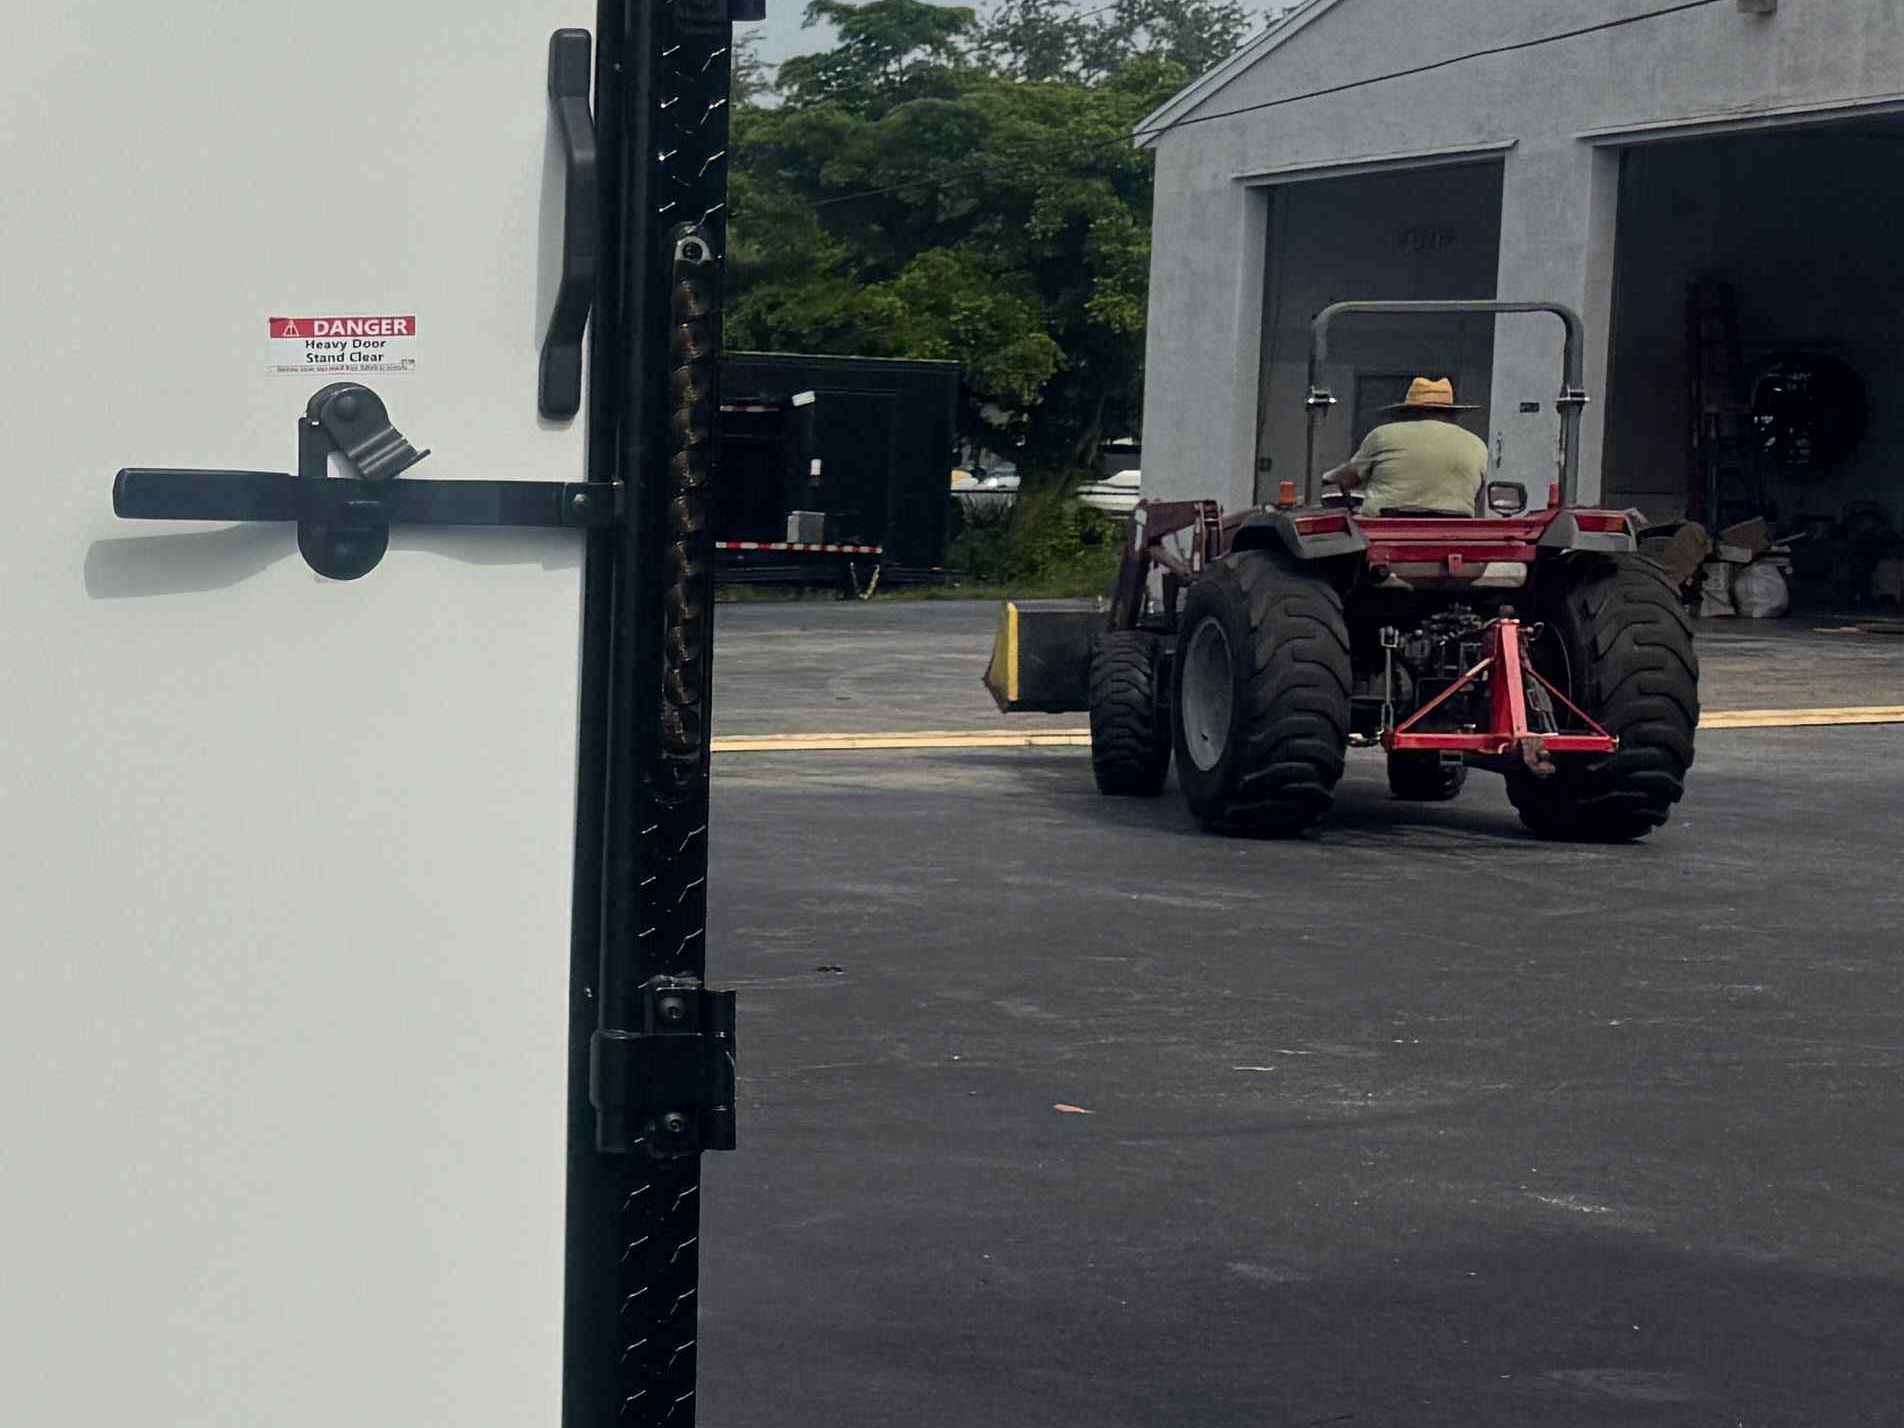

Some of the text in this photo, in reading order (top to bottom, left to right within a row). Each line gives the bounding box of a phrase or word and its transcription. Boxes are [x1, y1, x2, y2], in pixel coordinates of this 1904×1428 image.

[313, 319, 408, 336] DANGER
[305, 339, 387, 351] Heavy Door
[306, 351, 384, 363] Stand Clear
